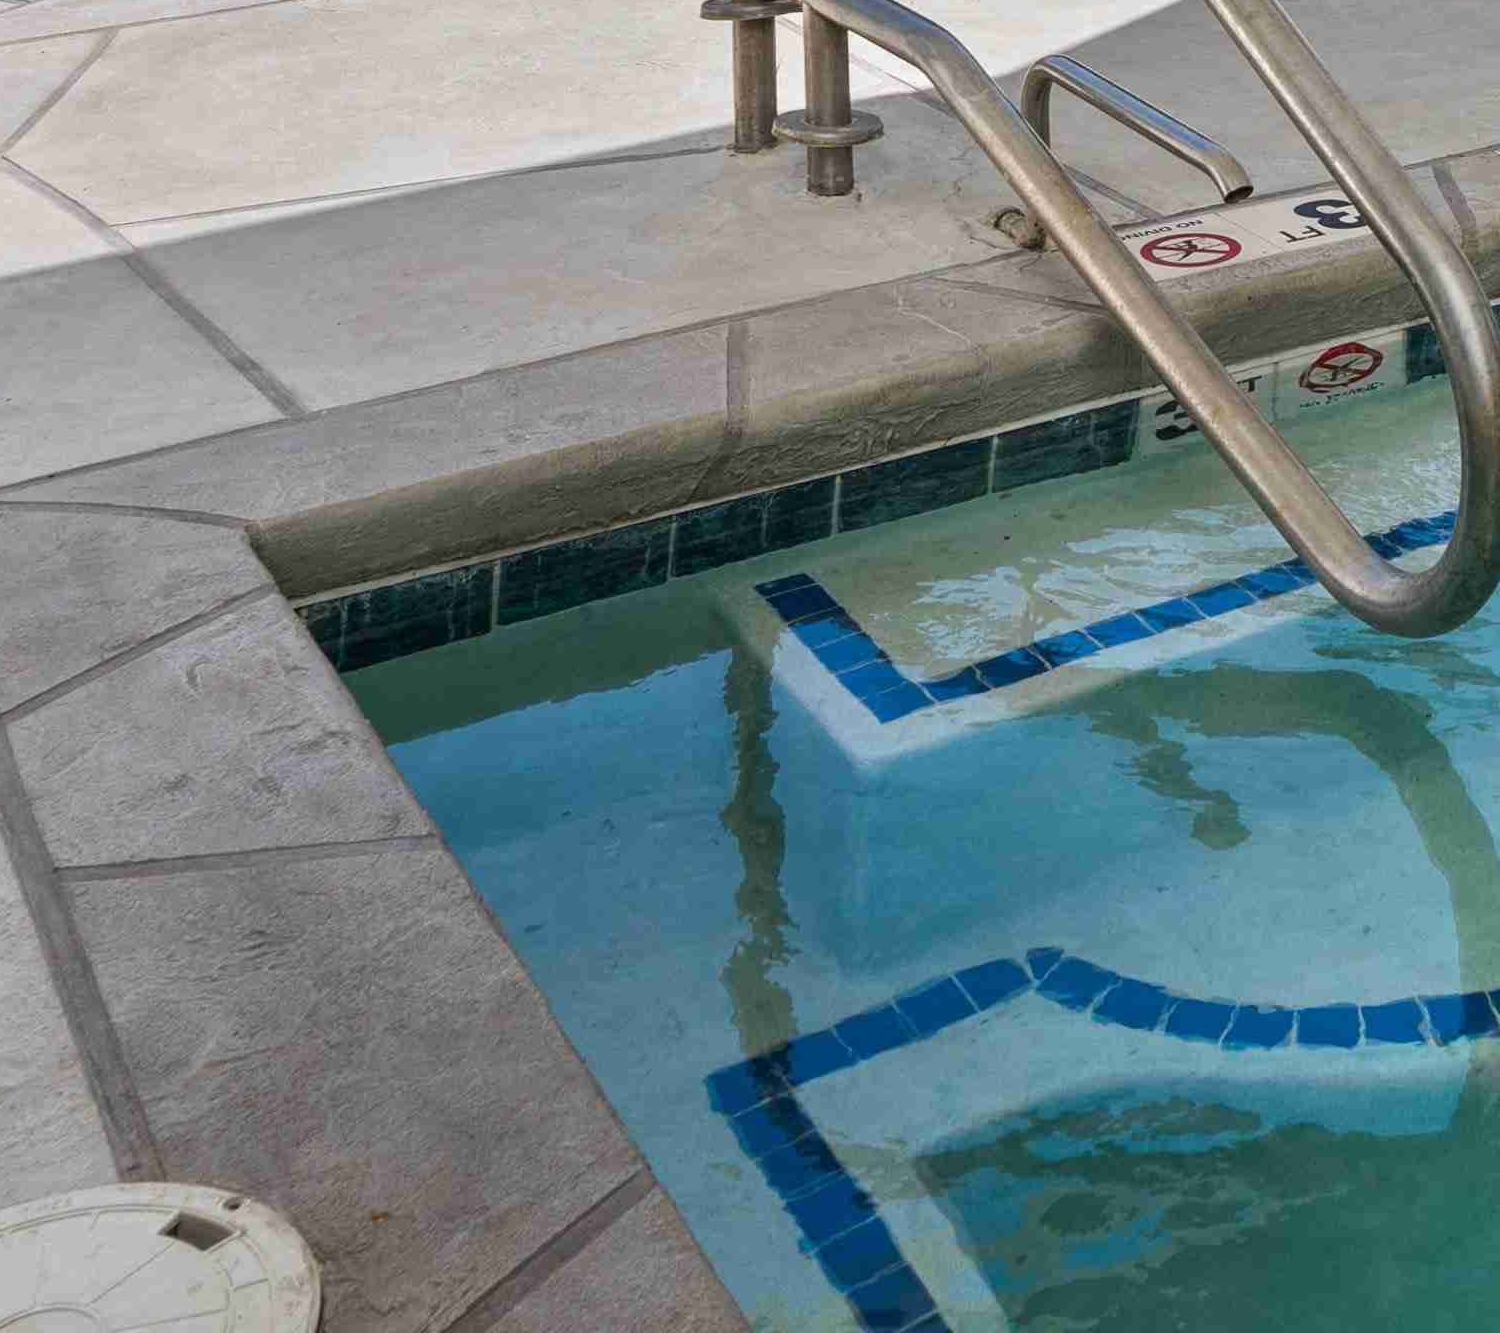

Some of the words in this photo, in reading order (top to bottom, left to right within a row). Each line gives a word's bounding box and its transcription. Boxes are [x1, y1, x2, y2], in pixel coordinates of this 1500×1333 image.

[1176, 219, 1203, 228] NO
[1294, 199, 1369, 230] 3
[1280, 225, 1325, 244] FT
